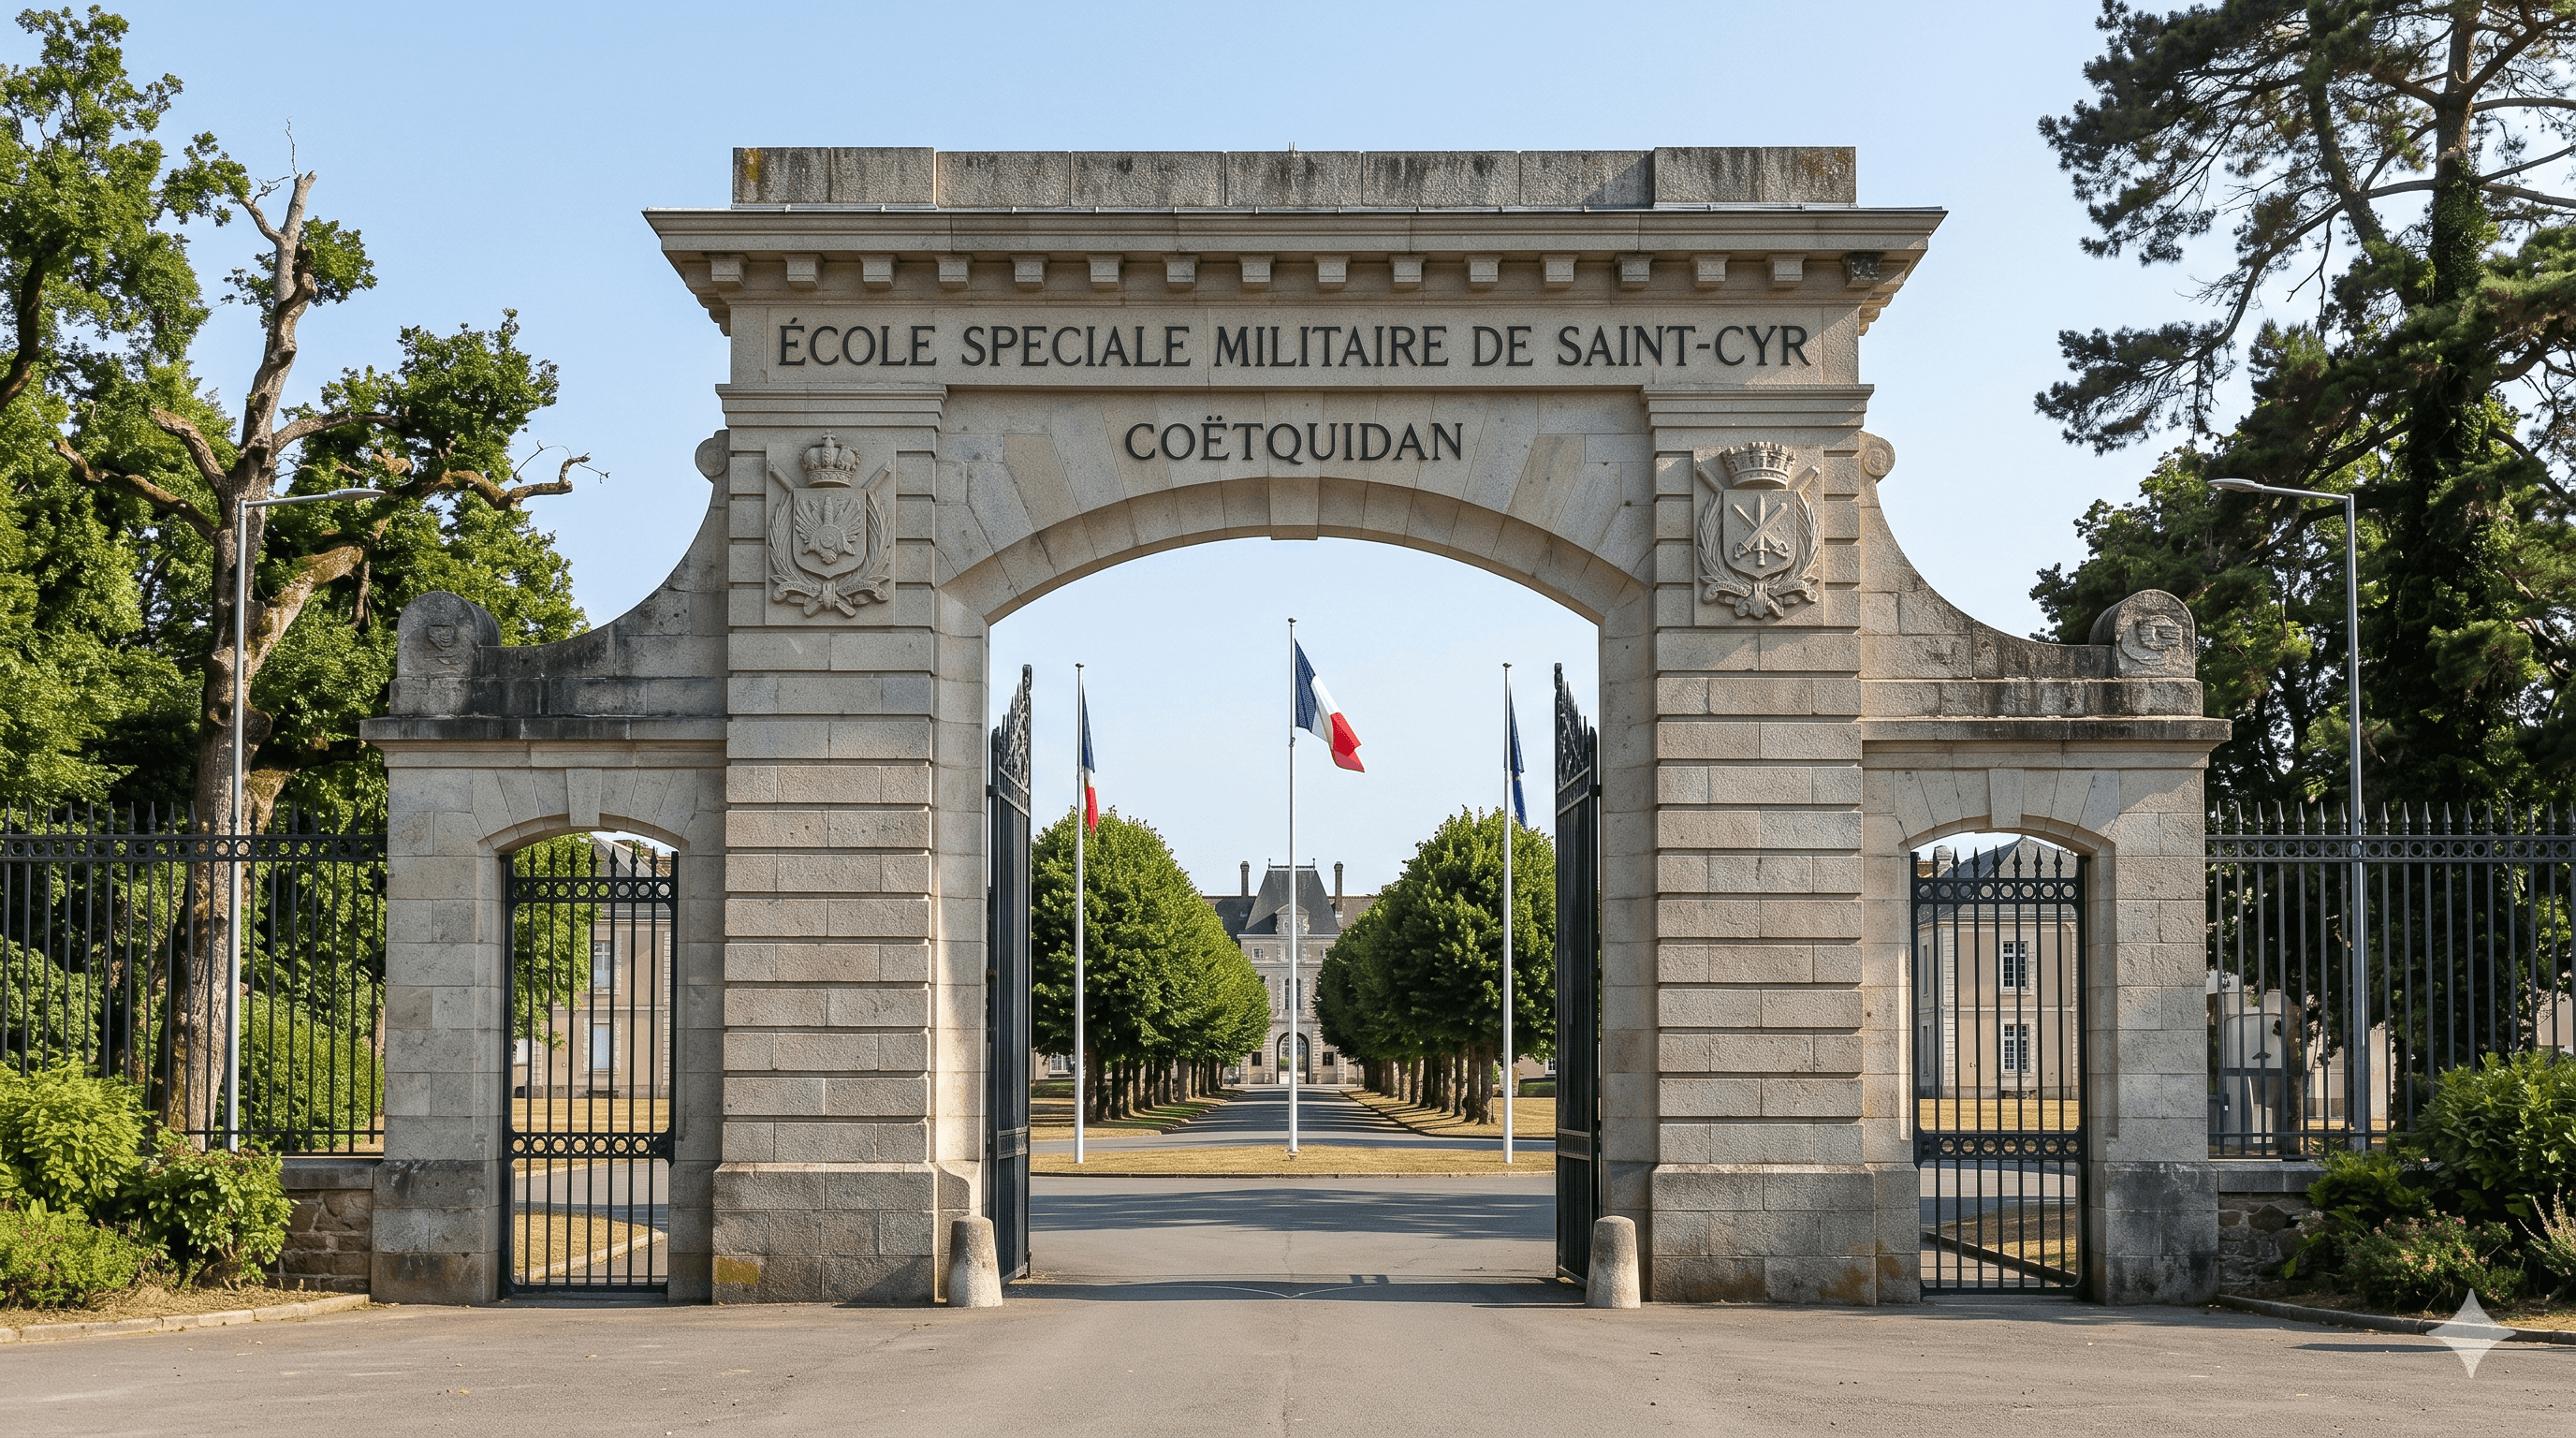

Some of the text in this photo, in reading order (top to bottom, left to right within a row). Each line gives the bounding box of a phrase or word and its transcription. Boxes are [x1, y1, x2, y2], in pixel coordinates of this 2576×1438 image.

[778, 316, 1811, 367] ÉCOLE SPECIALE MILITAIRE DE SAINT-CYR
[1124, 415, 1463, 465] COËTQUIDAN
